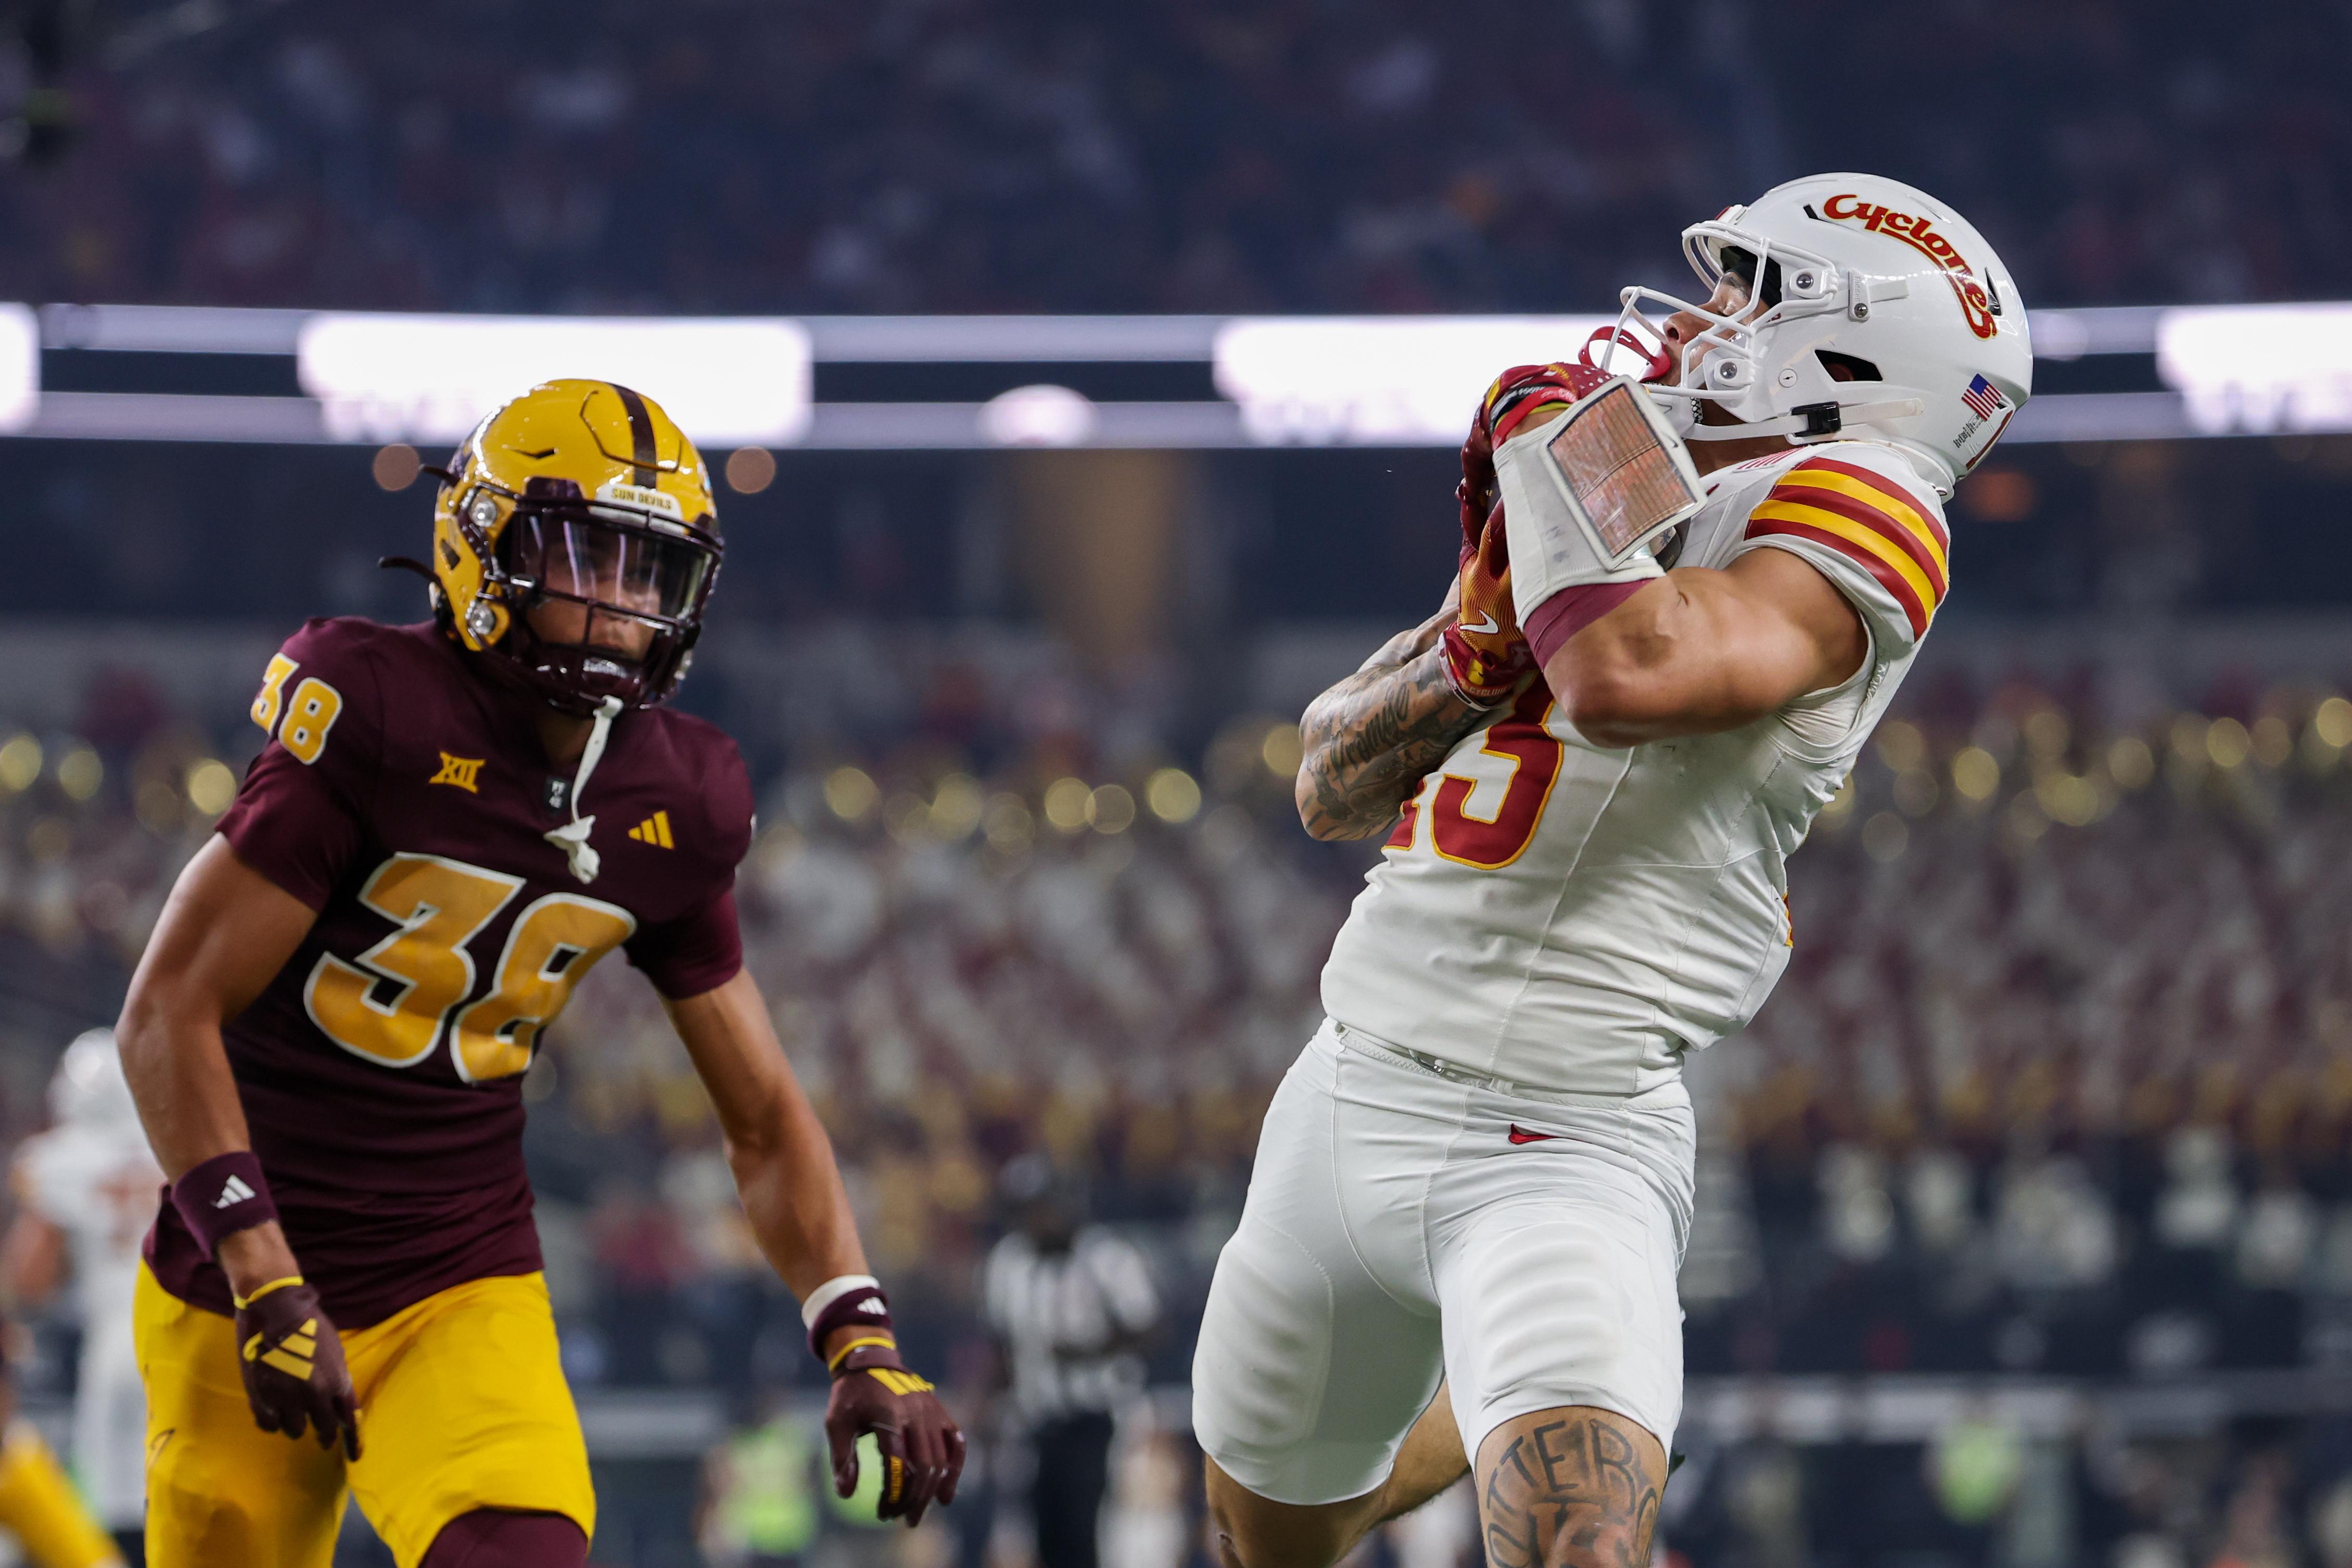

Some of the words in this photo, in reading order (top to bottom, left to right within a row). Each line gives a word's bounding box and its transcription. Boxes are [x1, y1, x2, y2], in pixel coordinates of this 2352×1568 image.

[1823, 194, 1998, 340] Cyclones
[612, 487, 634, 501] SUN
[638, 492, 672, 510] DEVILS
[250, 653, 343, 765] 38
[303, 852, 637, 1083] 38
